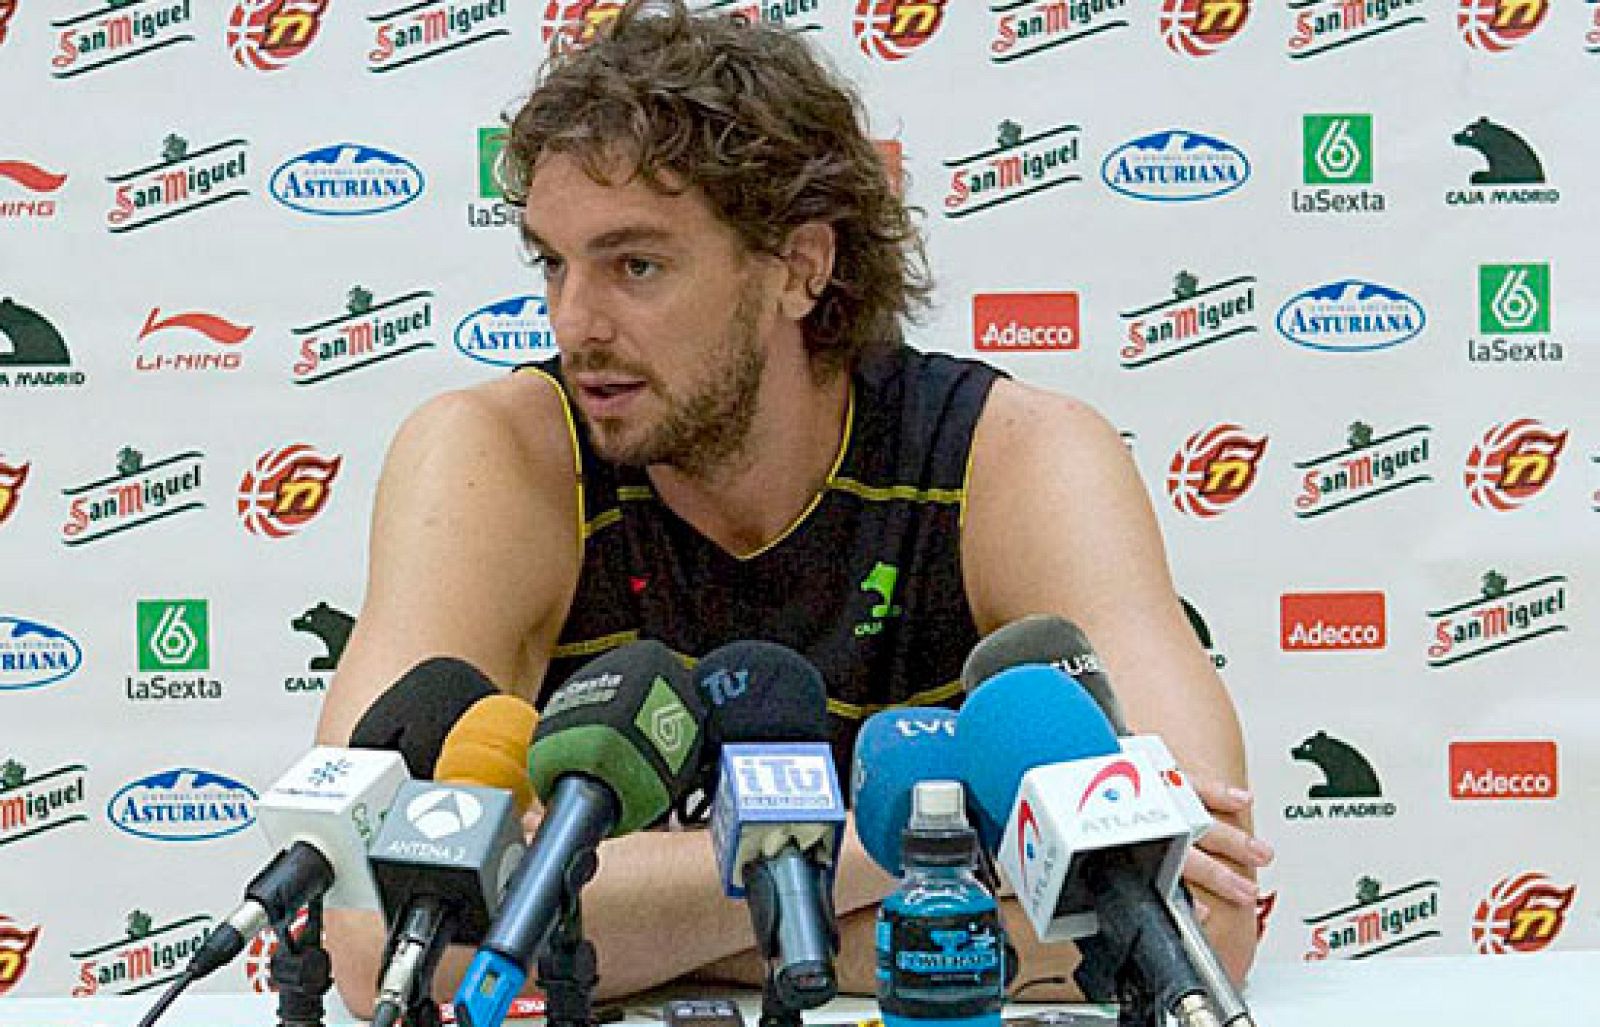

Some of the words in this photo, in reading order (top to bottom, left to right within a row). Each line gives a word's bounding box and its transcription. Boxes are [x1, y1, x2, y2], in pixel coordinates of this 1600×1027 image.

[1114, 157, 1238, 184] ASTURIANA
[283, 172, 411, 199] ASTURIANA
[1445, 189, 1485, 205] CAJA
[1489, 189, 1560, 205] MADRID
[1291, 189, 1386, 213] laSexta
[1289, 307, 1414, 333] ASTURIANA
[470, 322, 552, 350] ASTURI
[981, 321, 1073, 347] Adecco
[136, 353, 242, 370] LI-NING
[1467, 339, 1563, 362] laSexta
[14, 372, 86, 386] MADRID
[1289, 621, 1379, 646] Adecco
[125, 675, 222, 699] laSexta
[284, 677, 326, 692] CAJA
[1457, 769, 1550, 793] Adecco
[122, 797, 249, 822] ASTURIANA
[1284, 804, 1322, 819] CAJA
[1328, 803, 1397, 818] MADRID
